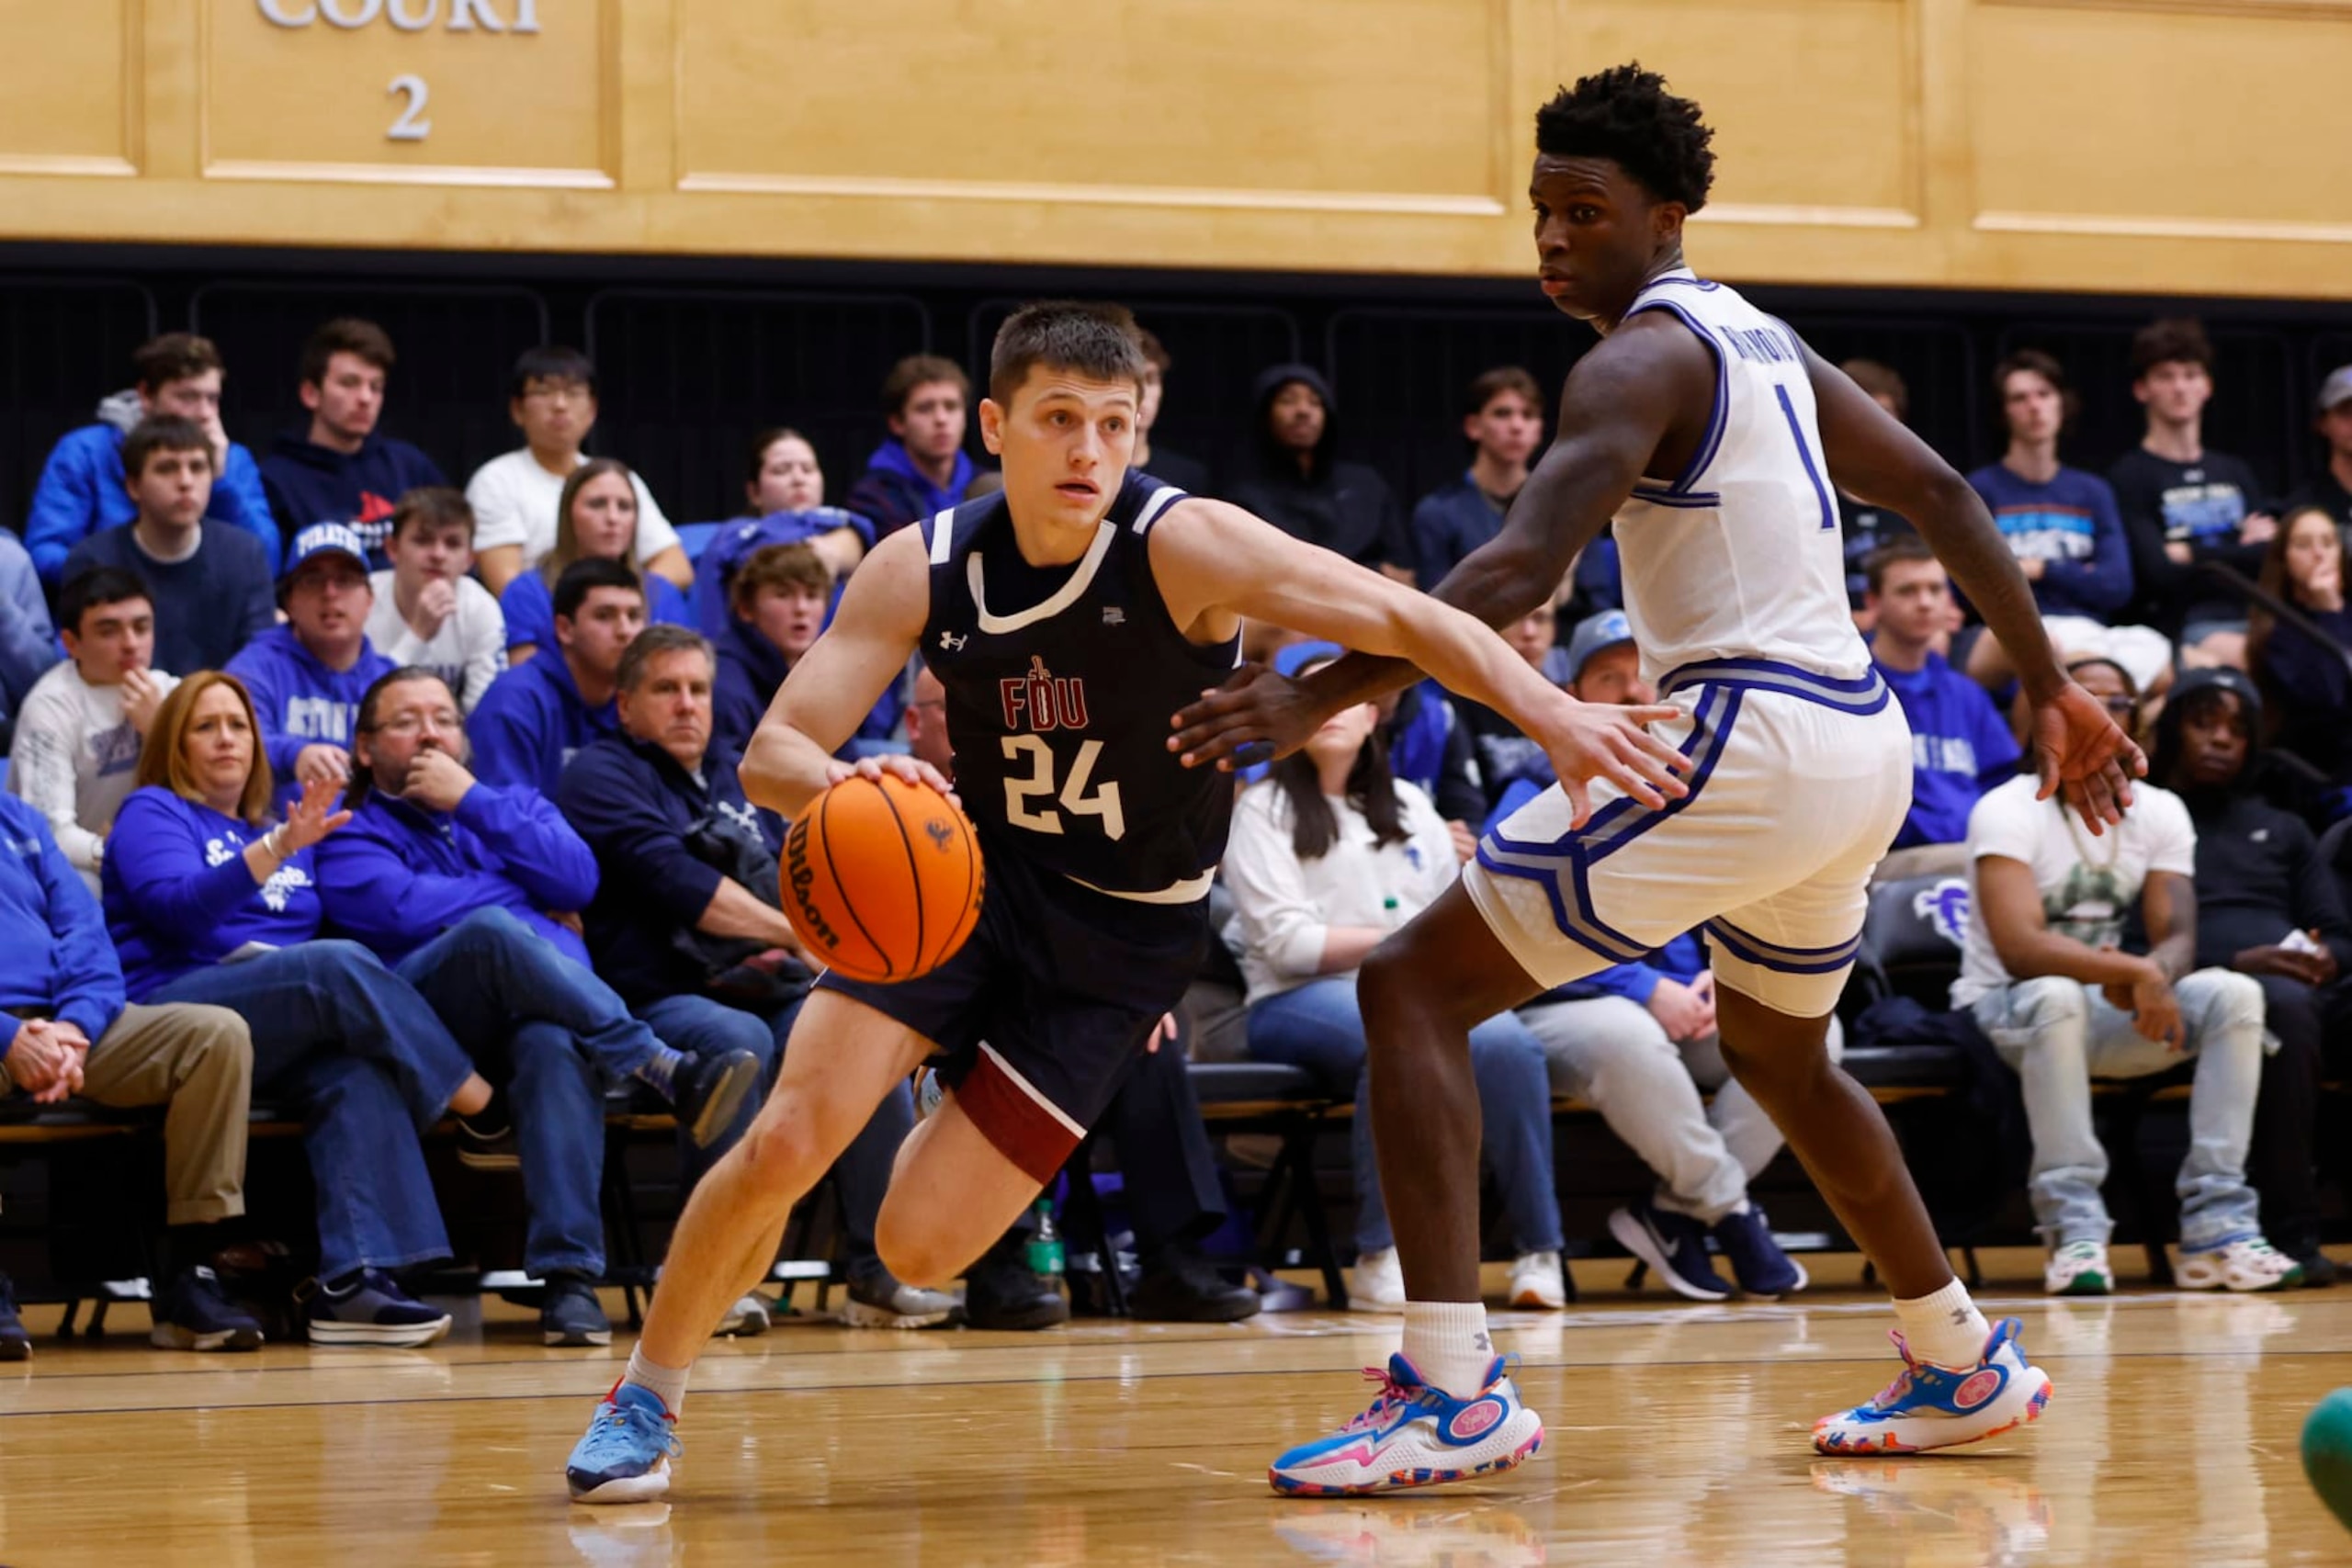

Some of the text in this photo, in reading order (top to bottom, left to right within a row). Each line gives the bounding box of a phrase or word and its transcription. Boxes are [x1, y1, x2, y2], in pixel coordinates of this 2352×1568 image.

[387, 73, 431, 139] 2
[1773, 383, 1835, 530] 1
[1000, 676, 1090, 731] FDU
[1000, 734, 1126, 842] 24
[787, 813, 840, 949] Wilson
